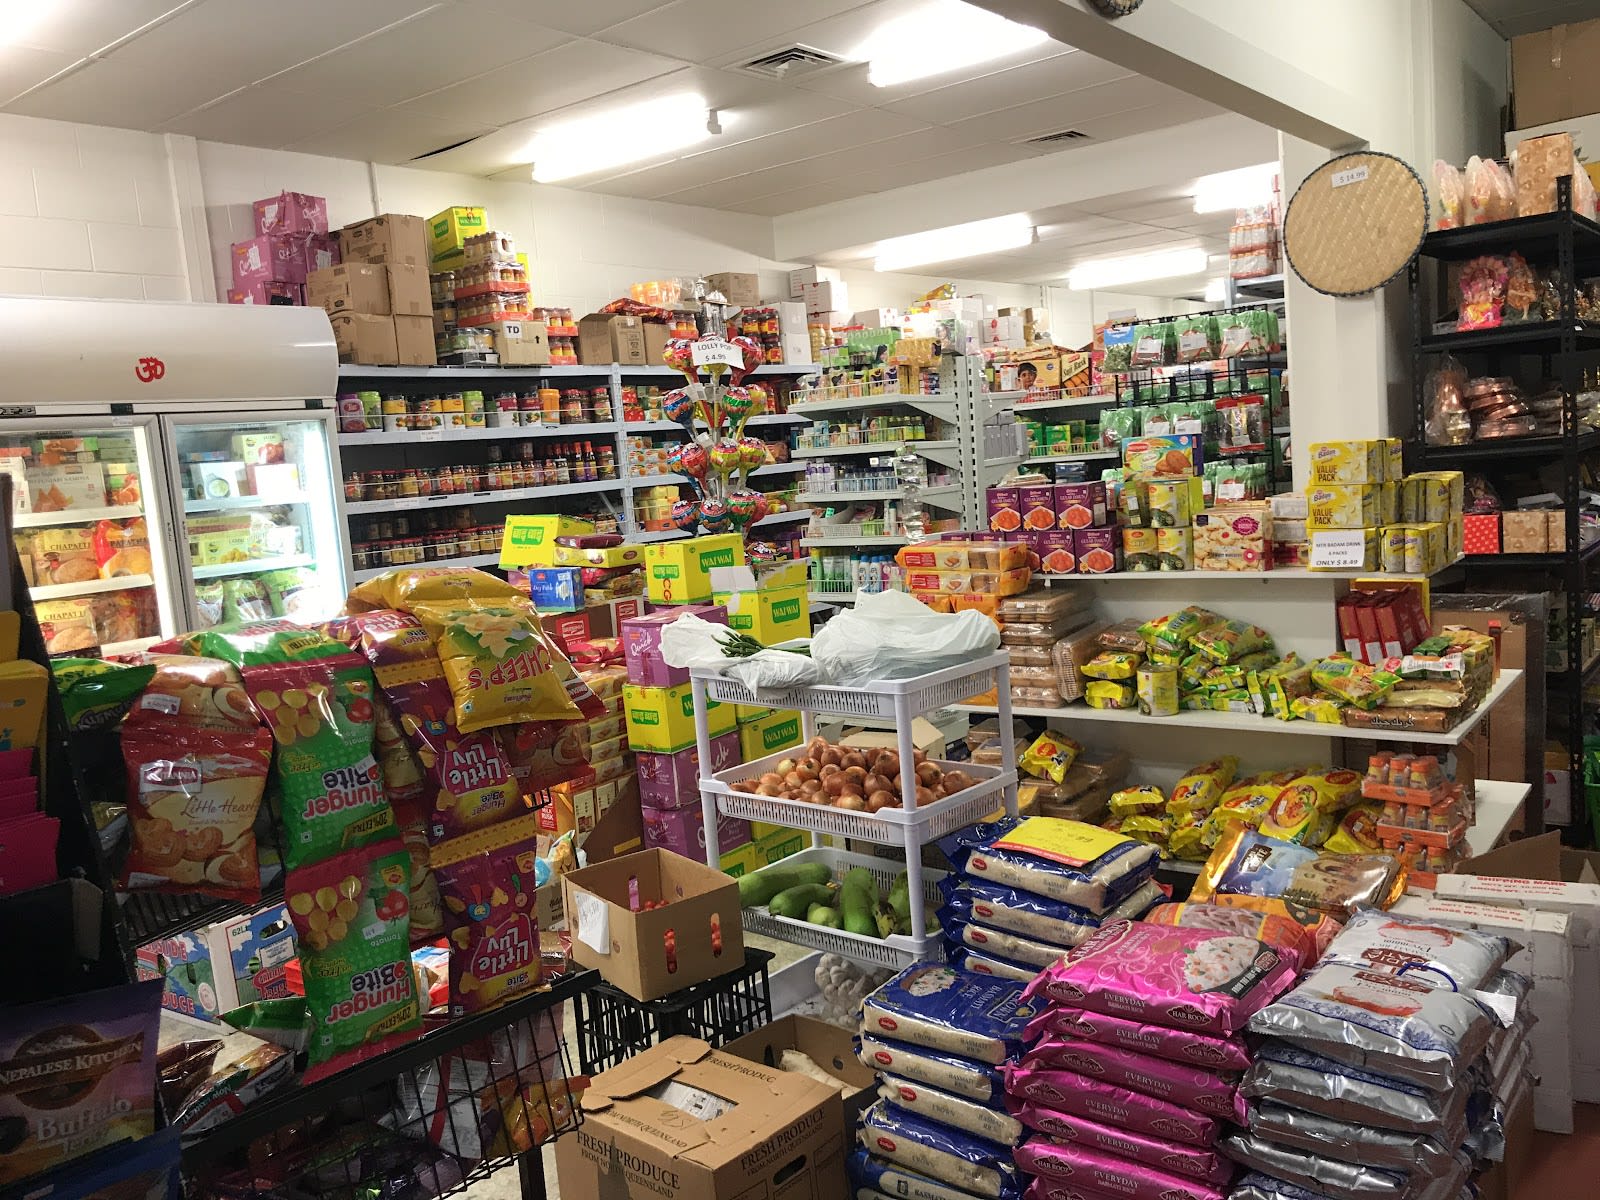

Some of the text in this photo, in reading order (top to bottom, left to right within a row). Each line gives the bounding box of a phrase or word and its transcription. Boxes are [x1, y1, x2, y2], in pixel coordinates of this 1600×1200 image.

[506, 325, 520, 334] TD
[697, 342, 719, 352] LOLLY
[1316, 465, 1338, 474] VALUE
[1318, 473, 1336, 481] PACK
[1313, 508, 1333, 517] VALUE
[1314, 516, 1331, 525] PACK
[702, 555, 732, 567] WAI WAI
[773, 604, 799, 618] WAI WAI
[630, 631, 653, 657] Quick
[469, 645, 552, 691] CHEEP'S
[343, 735, 369, 747] omato
[765, 725, 796, 743] WAI WAI
[452, 743, 486, 766] Luv
[321, 767, 369, 790] Bite
[449, 757, 502, 789] Little
[181, 795, 216, 818] Little
[302, 784, 386, 821] Hunger
[372, 811, 388, 827] 20%
[1477, 876, 1530, 884] SHIPPING
[370, 932, 401, 948] Tomato
[487, 926, 518, 953] Luv
[478, 940, 529, 974] Little
[350, 961, 395, 993] Bite
[507, 972, 525, 986] Bite
[961, 984, 983, 999] RICE
[971, 984, 1003, 1010] BASMATI
[1104, 992, 1146, 1008] EVERYDAY
[326, 979, 411, 1024] Hunger
[396, 1005, 411, 1020] 20%
[1172, 1011, 1208, 1023] HAR ROOZ
[1116, 1029, 1161, 1044] EVERYDAY
[0, 1060, 72, 1085] NEPALESE
[75, 1041, 141, 1071] KITCHEN
[707, 1055, 738, 1072] FRESH
[1125, 1071, 1173, 1091] EVERYDAY
[1085, 1099, 1130, 1117] EVERYDAY
[1214, 1101, 1233, 1112] ROO
[618, 1112, 643, 1129] NORTH
[640, 1123, 688, 1148] QUEENSLAND
[1155, 1121, 1171, 1131] HAR
[741, 1107, 825, 1171] FRESH PRODUCE
[1096, 1134, 1141, 1153] EVERYDAY
[577, 1130, 681, 1190] FRESH PRODUCE
[1038, 1160, 1069, 1174] HAR ROOZ
[581, 1148, 599, 1162] FROM
[625, 1170, 674, 1199] QUEENSLAND
[1094, 1170, 1140, 1189] EVERYDAY
